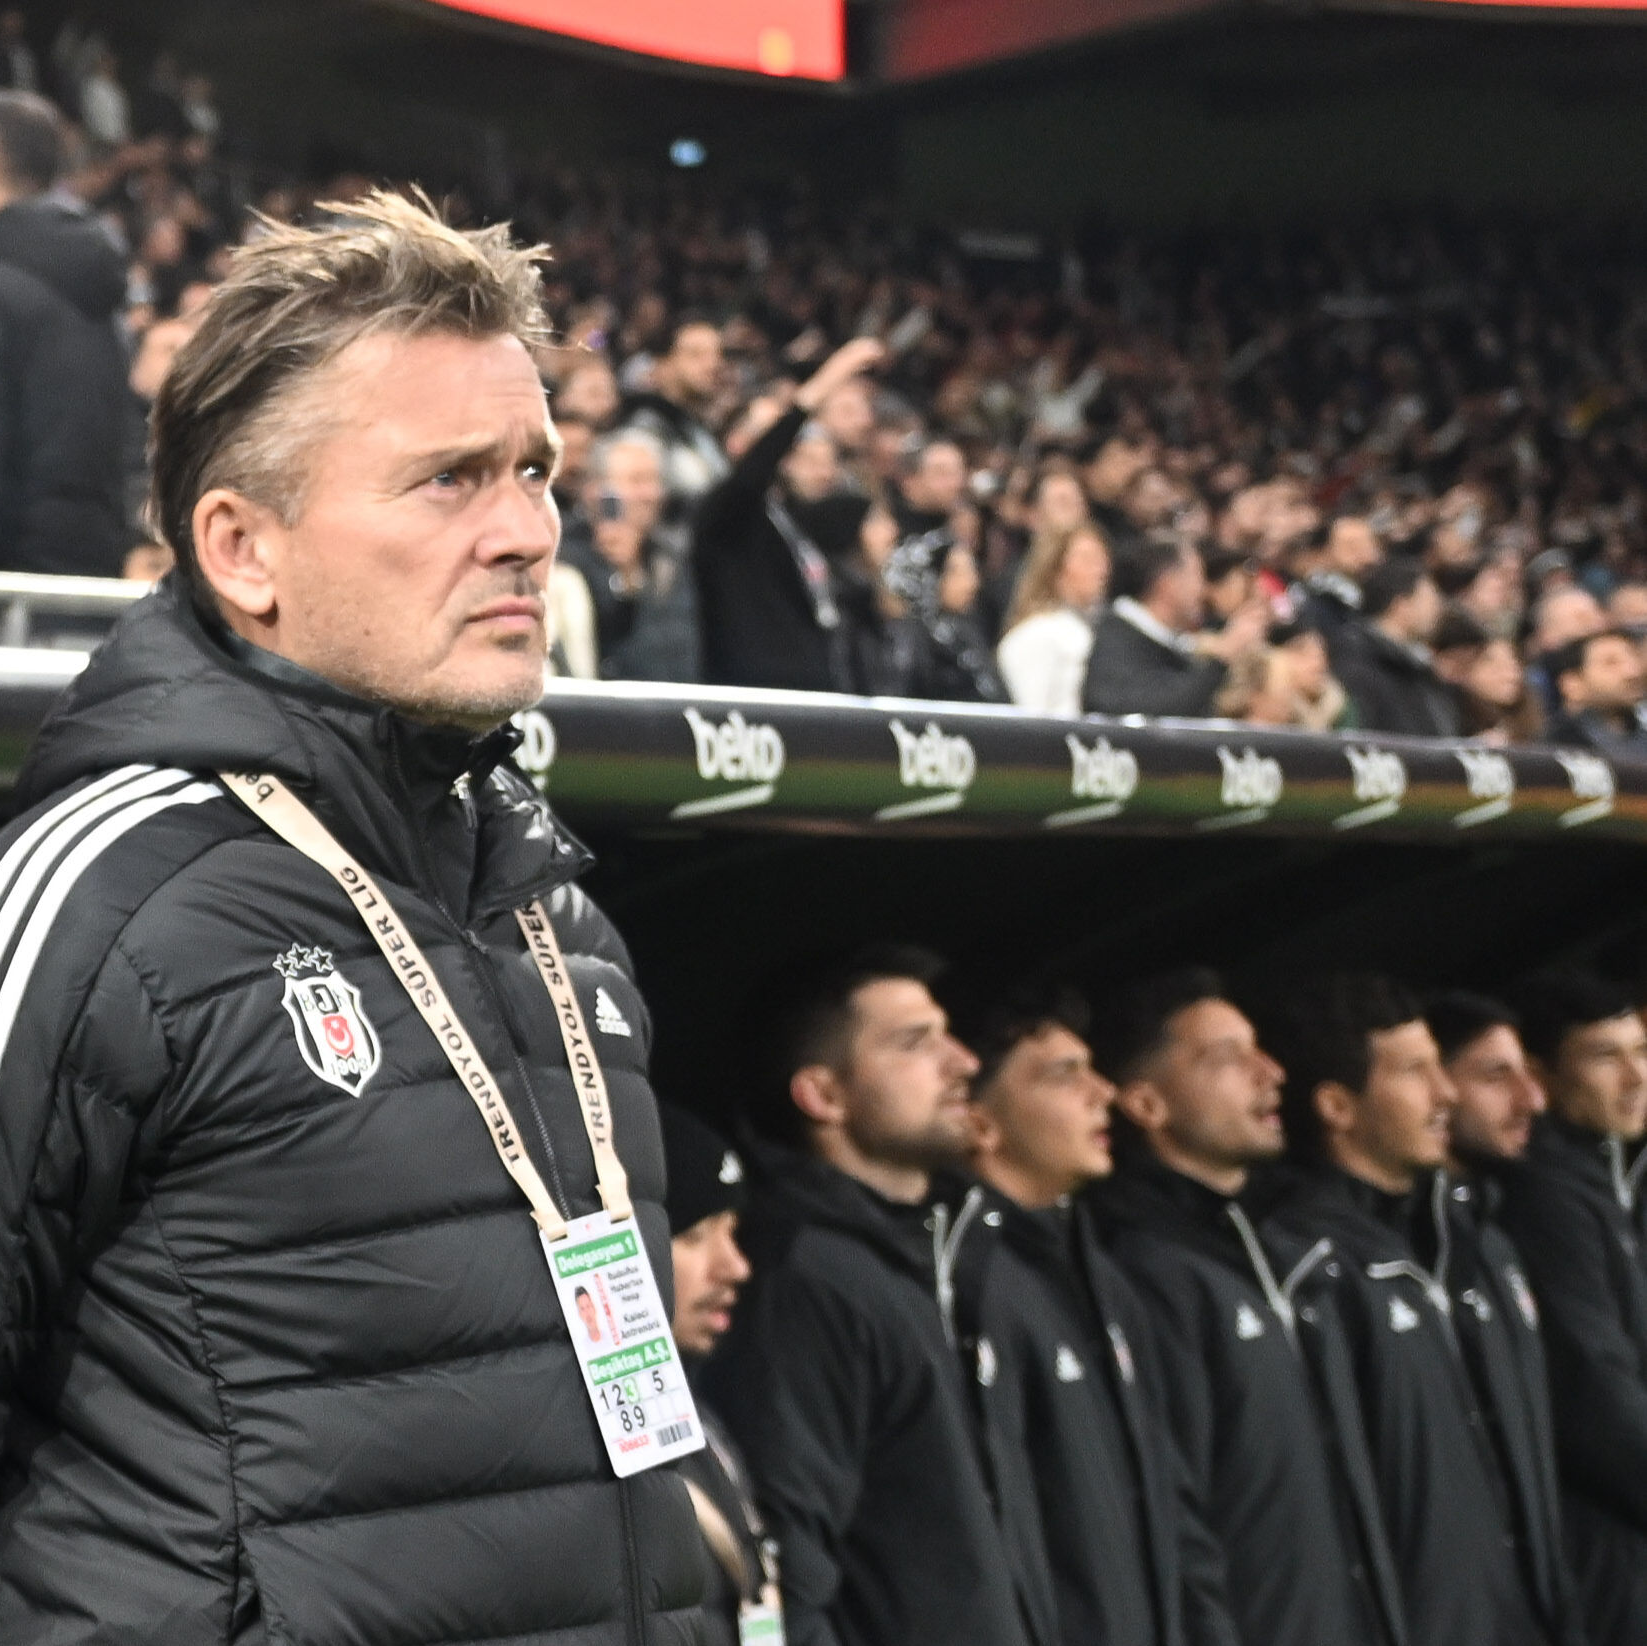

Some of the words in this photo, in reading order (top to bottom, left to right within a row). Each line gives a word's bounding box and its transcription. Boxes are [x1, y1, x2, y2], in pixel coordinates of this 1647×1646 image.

[683, 707, 786, 781] beko
[339, 866, 378, 910] LİG
[375, 913, 437, 1010] SÜPER
[439, 1013, 521, 1166] TRENDYOL
[559, 997, 607, 1146] TRENDYOL
[624, 1236, 635, 1251] 1
[599, 1388, 611, 1410] 1
[611, 1384, 625, 1406] 2
[651, 1370, 665, 1392] 5
[620, 1410, 633, 1433] 8
[633, 1405, 646, 1428] 9
